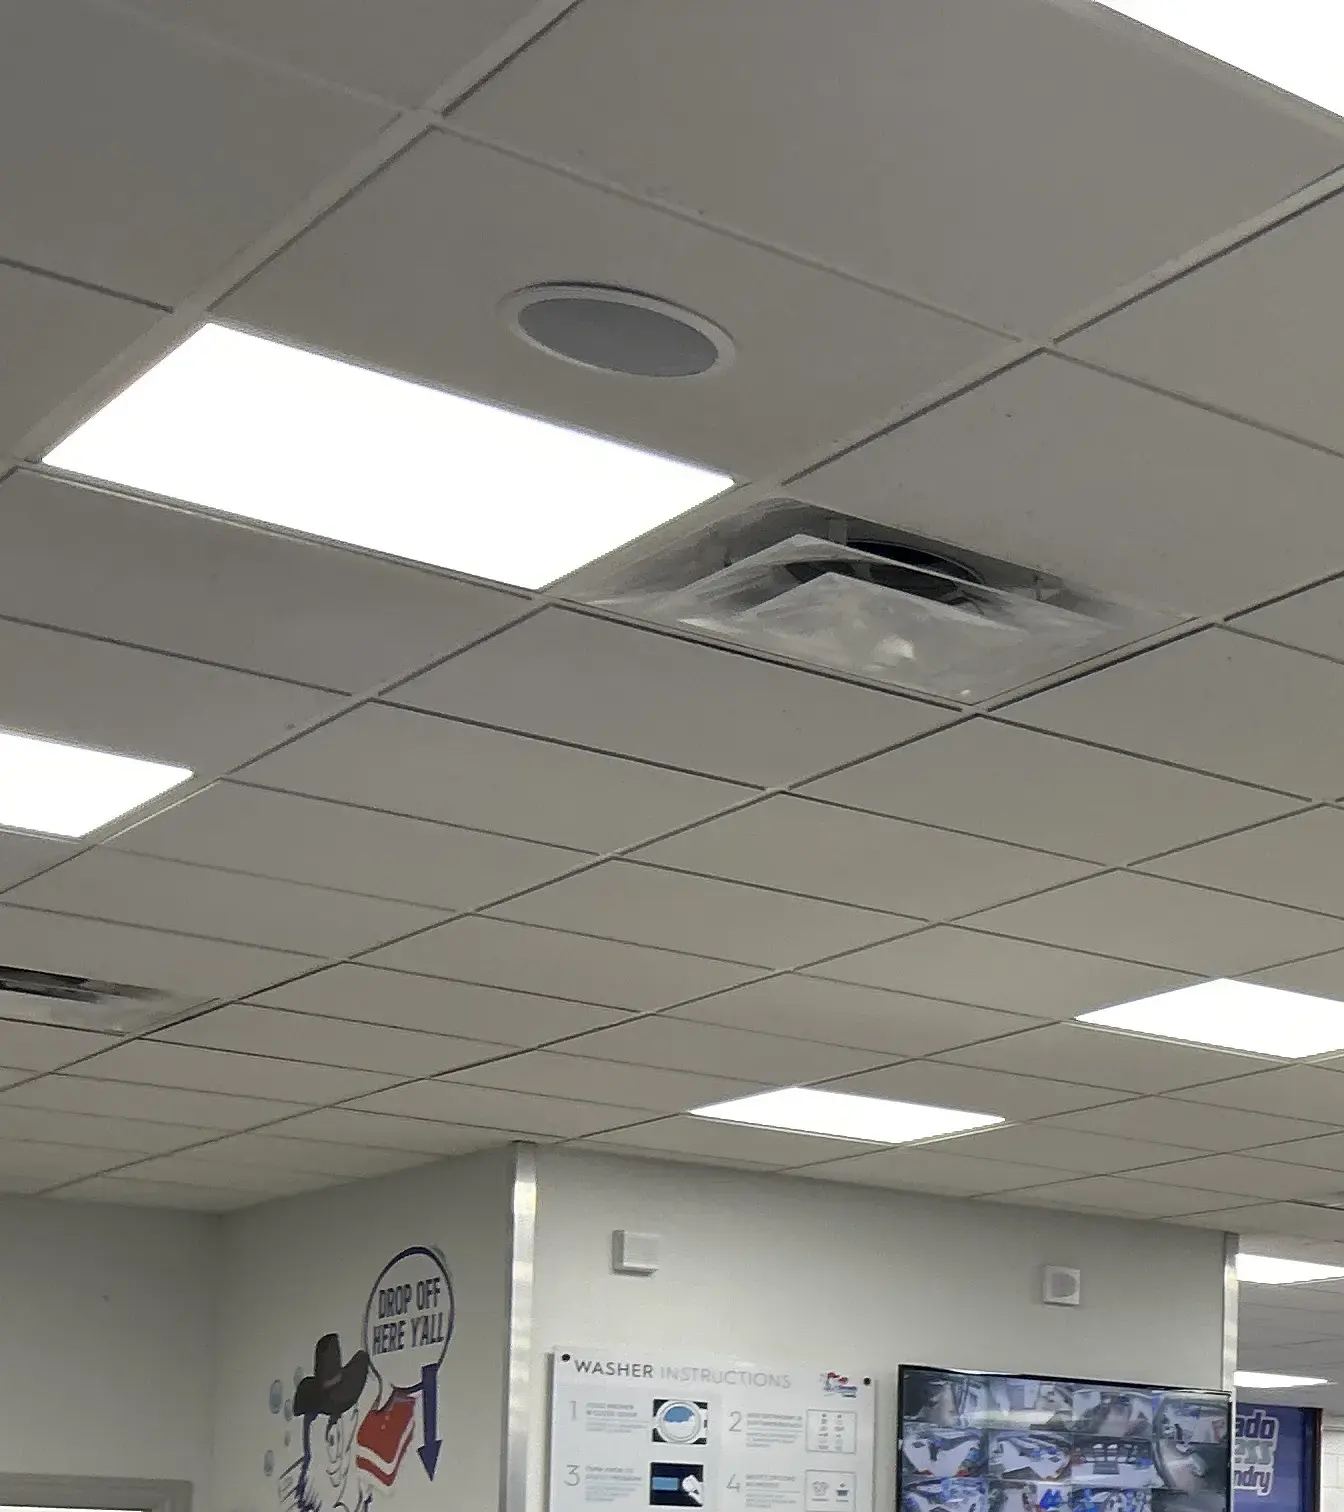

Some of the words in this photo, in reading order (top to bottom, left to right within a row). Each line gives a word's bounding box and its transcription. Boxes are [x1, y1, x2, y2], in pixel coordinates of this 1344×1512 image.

[379, 1284, 411, 1319] DROP
[417, 1277, 440, 1310] OFF
[372, 1320, 405, 1355] HERE
[574, 1360, 653, 1378] WASHER
[660, 1366, 791, 1389] INSTRUCTIONS
[570, 1400, 577, 1421] 1
[729, 1411, 742, 1432] 2
[564, 1464, 580, 1486] 3
[726, 1474, 740, 1492] 4
